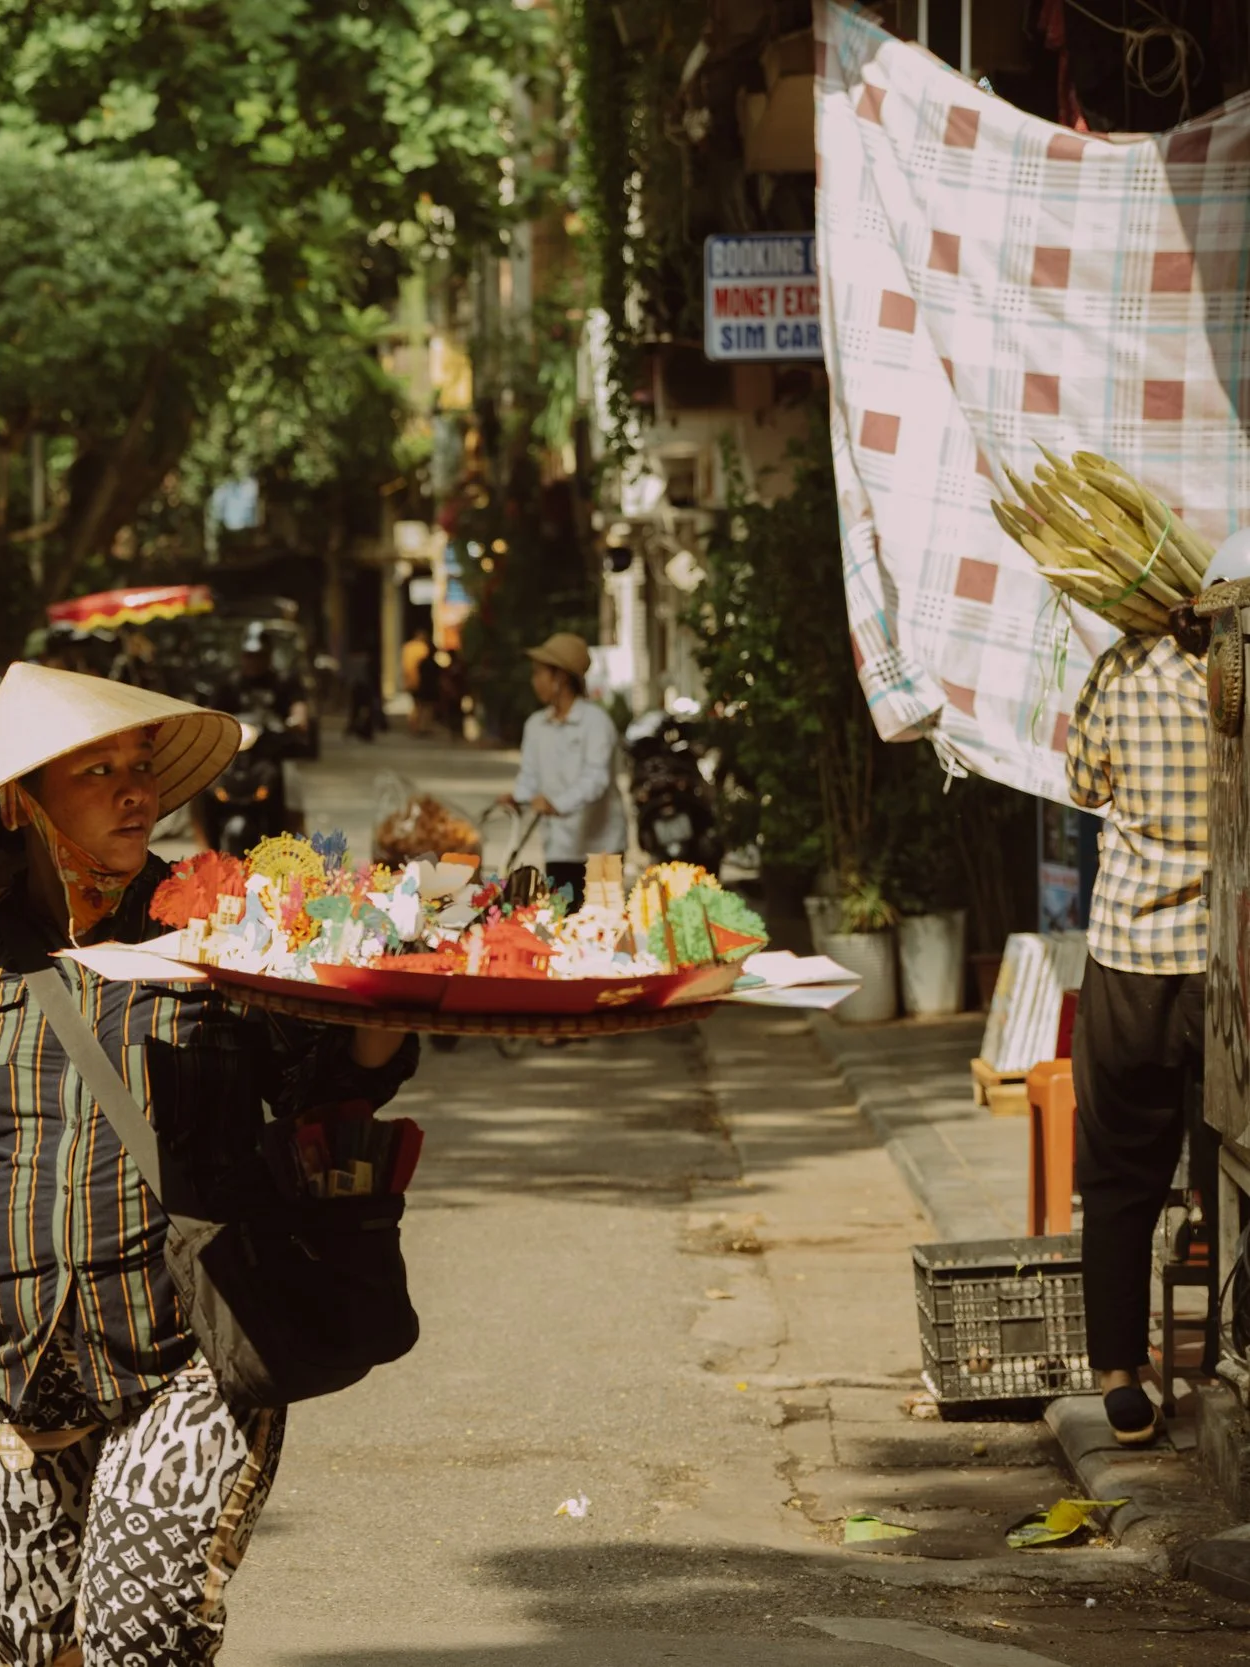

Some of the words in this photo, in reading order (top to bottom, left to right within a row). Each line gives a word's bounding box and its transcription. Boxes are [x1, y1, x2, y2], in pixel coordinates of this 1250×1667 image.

[711, 239, 804, 276] BOOKING
[714, 286, 775, 319] MONEY
[720, 323, 765, 351] SIM
